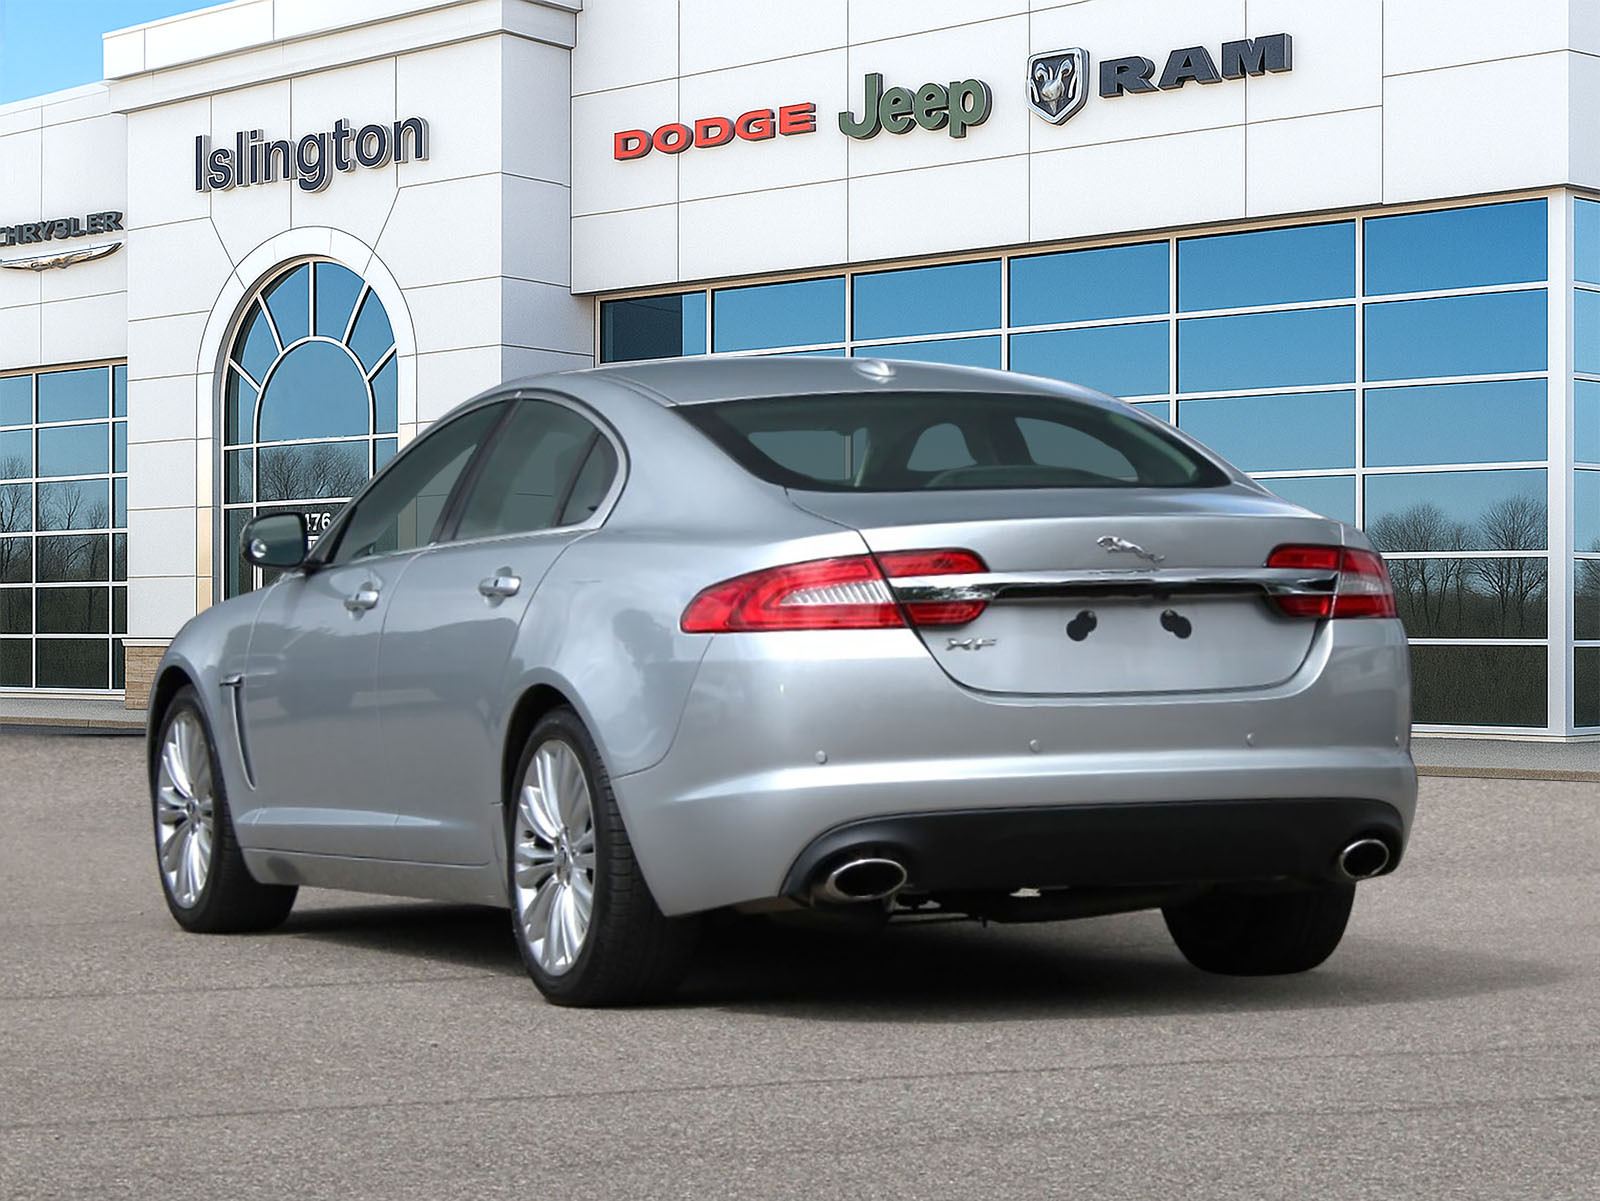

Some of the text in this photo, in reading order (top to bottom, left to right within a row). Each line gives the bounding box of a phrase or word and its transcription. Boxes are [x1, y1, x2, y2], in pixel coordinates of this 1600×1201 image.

[614, 33, 1293, 161] DODGE Jeep RAM
[195, 115, 429, 194] Islington
[945, 637, 998, 651] XF
